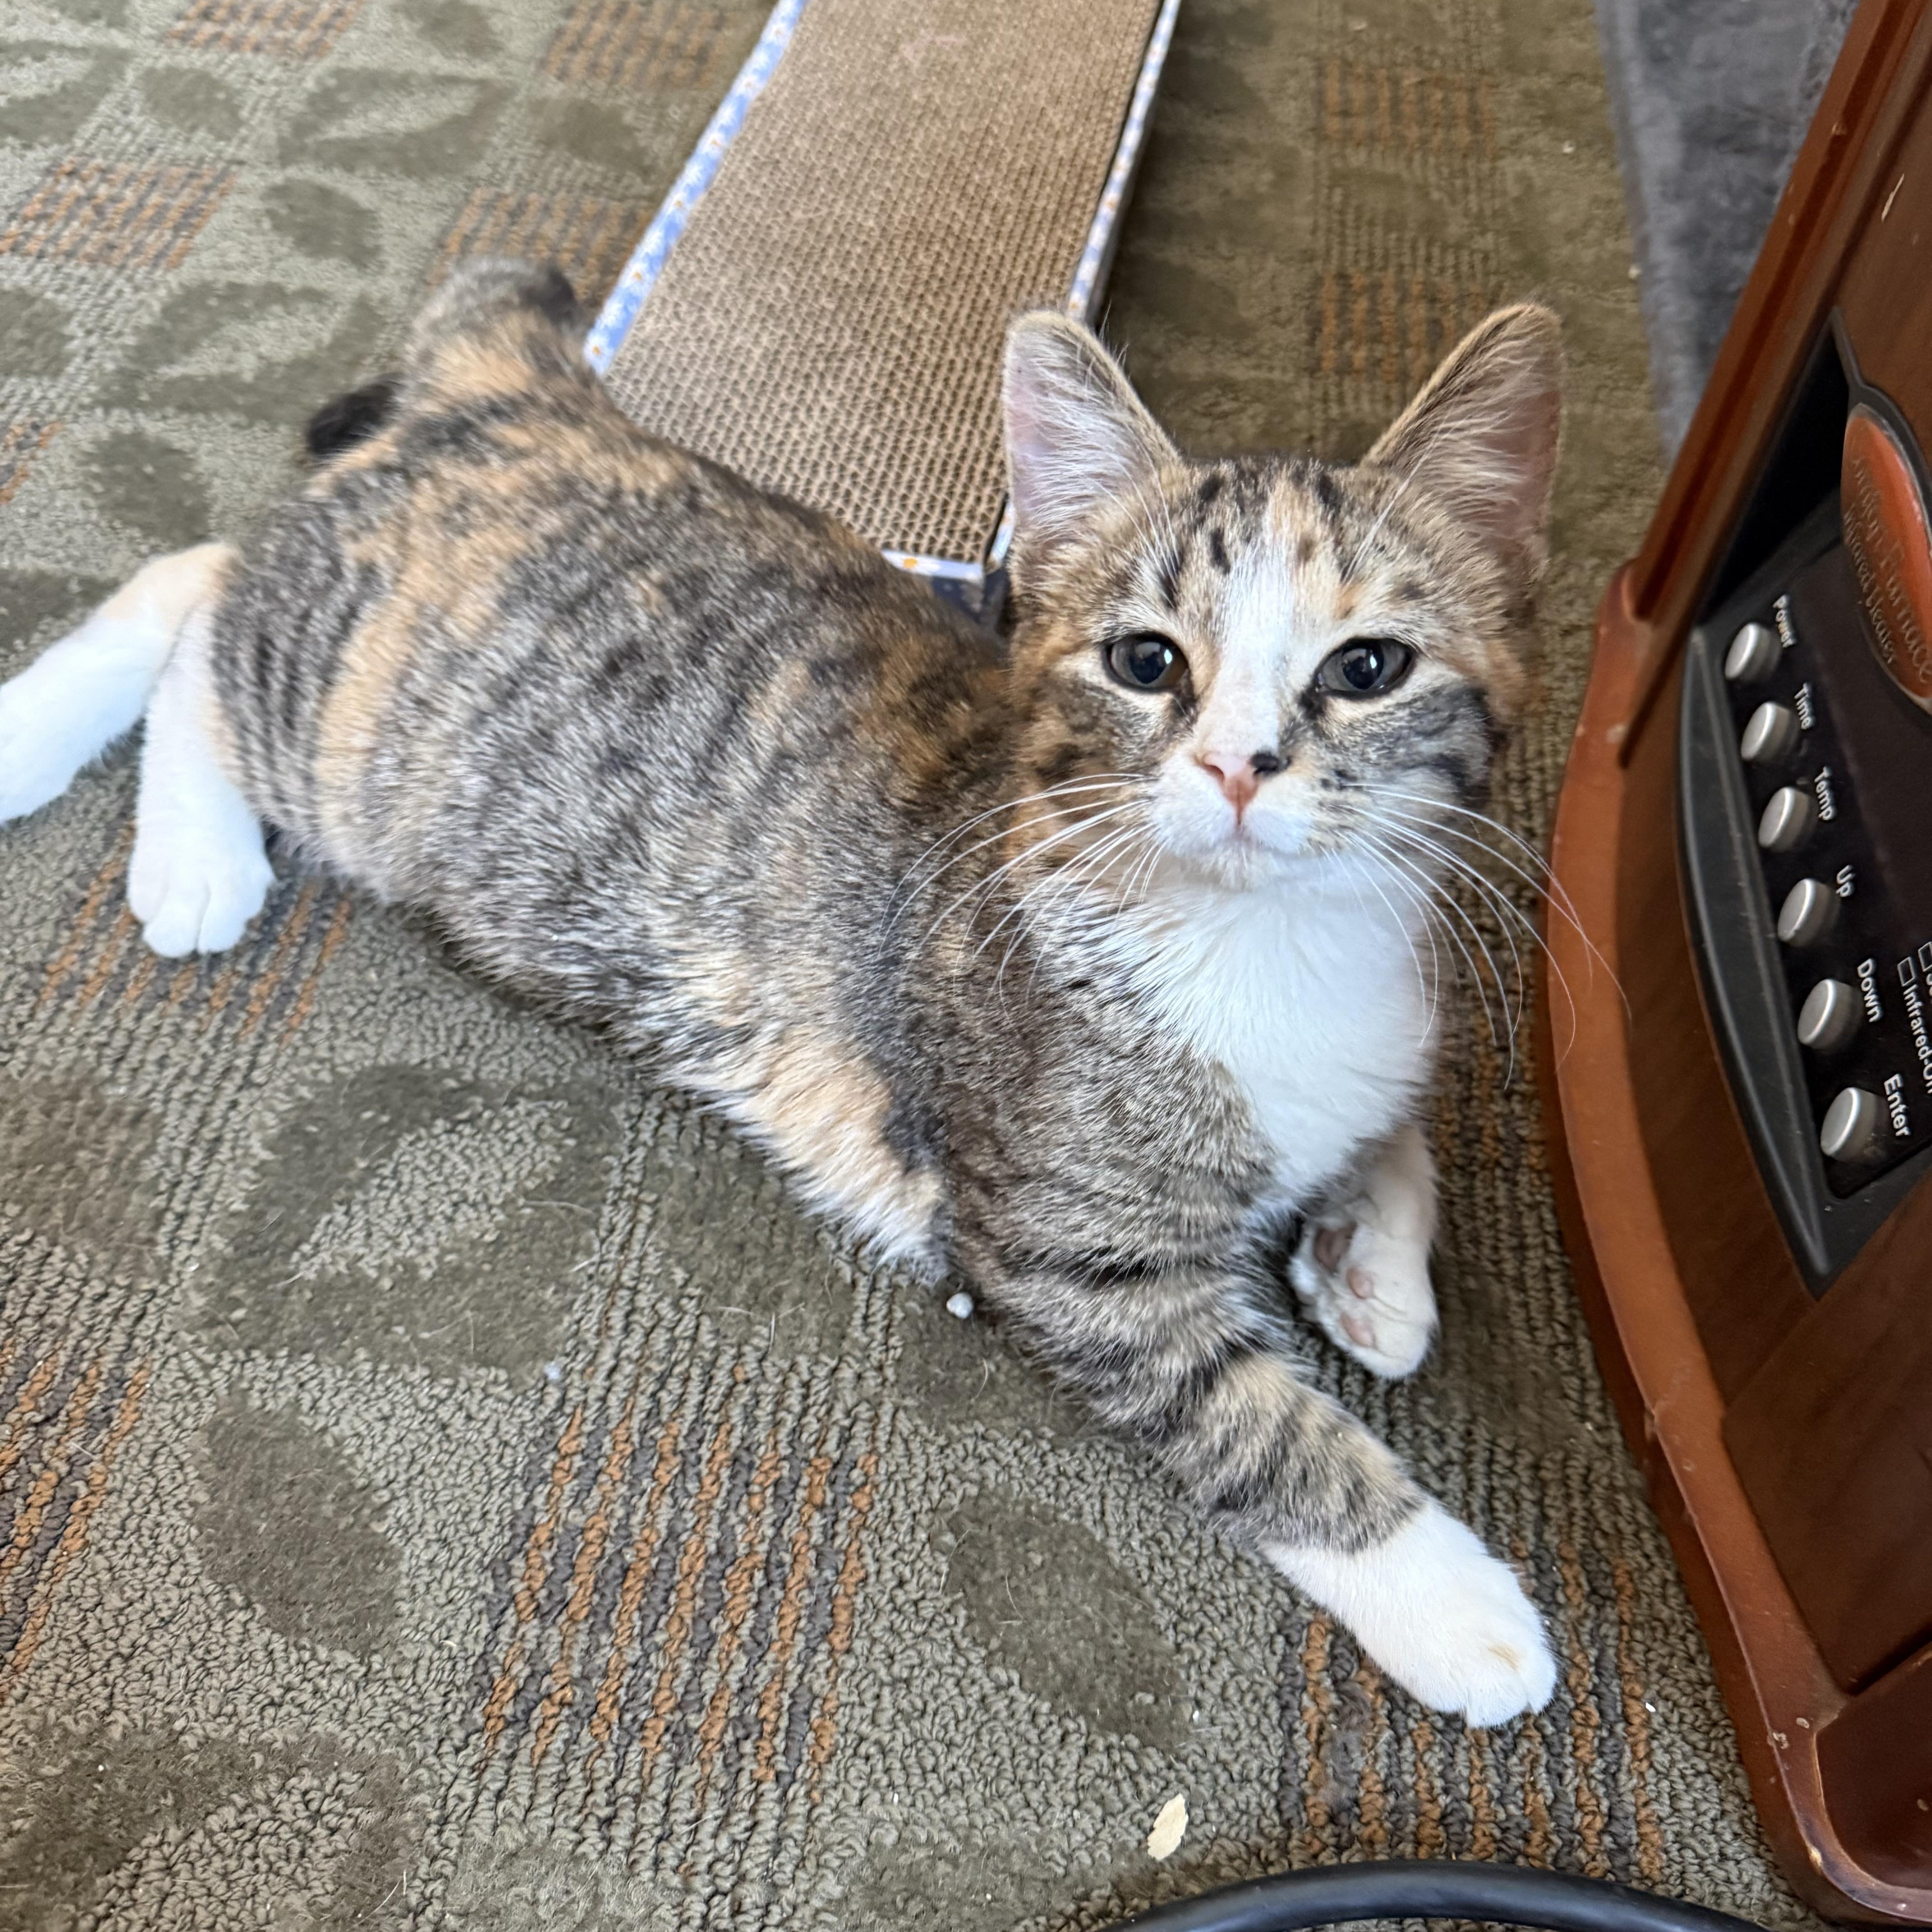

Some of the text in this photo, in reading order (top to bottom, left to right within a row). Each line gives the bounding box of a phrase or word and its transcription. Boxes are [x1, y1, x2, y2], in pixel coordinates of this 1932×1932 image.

[1773, 594, 1797, 648] Power
[1865, 586, 1896, 664] Heater
[1794, 682, 1815, 730] Time
[1814, 766, 1836, 821] Temp
[1835, 865, 1854, 898] Up
[1857, 958, 1883, 1023] Down
[1884, 1073, 1911, 1137] Enter
